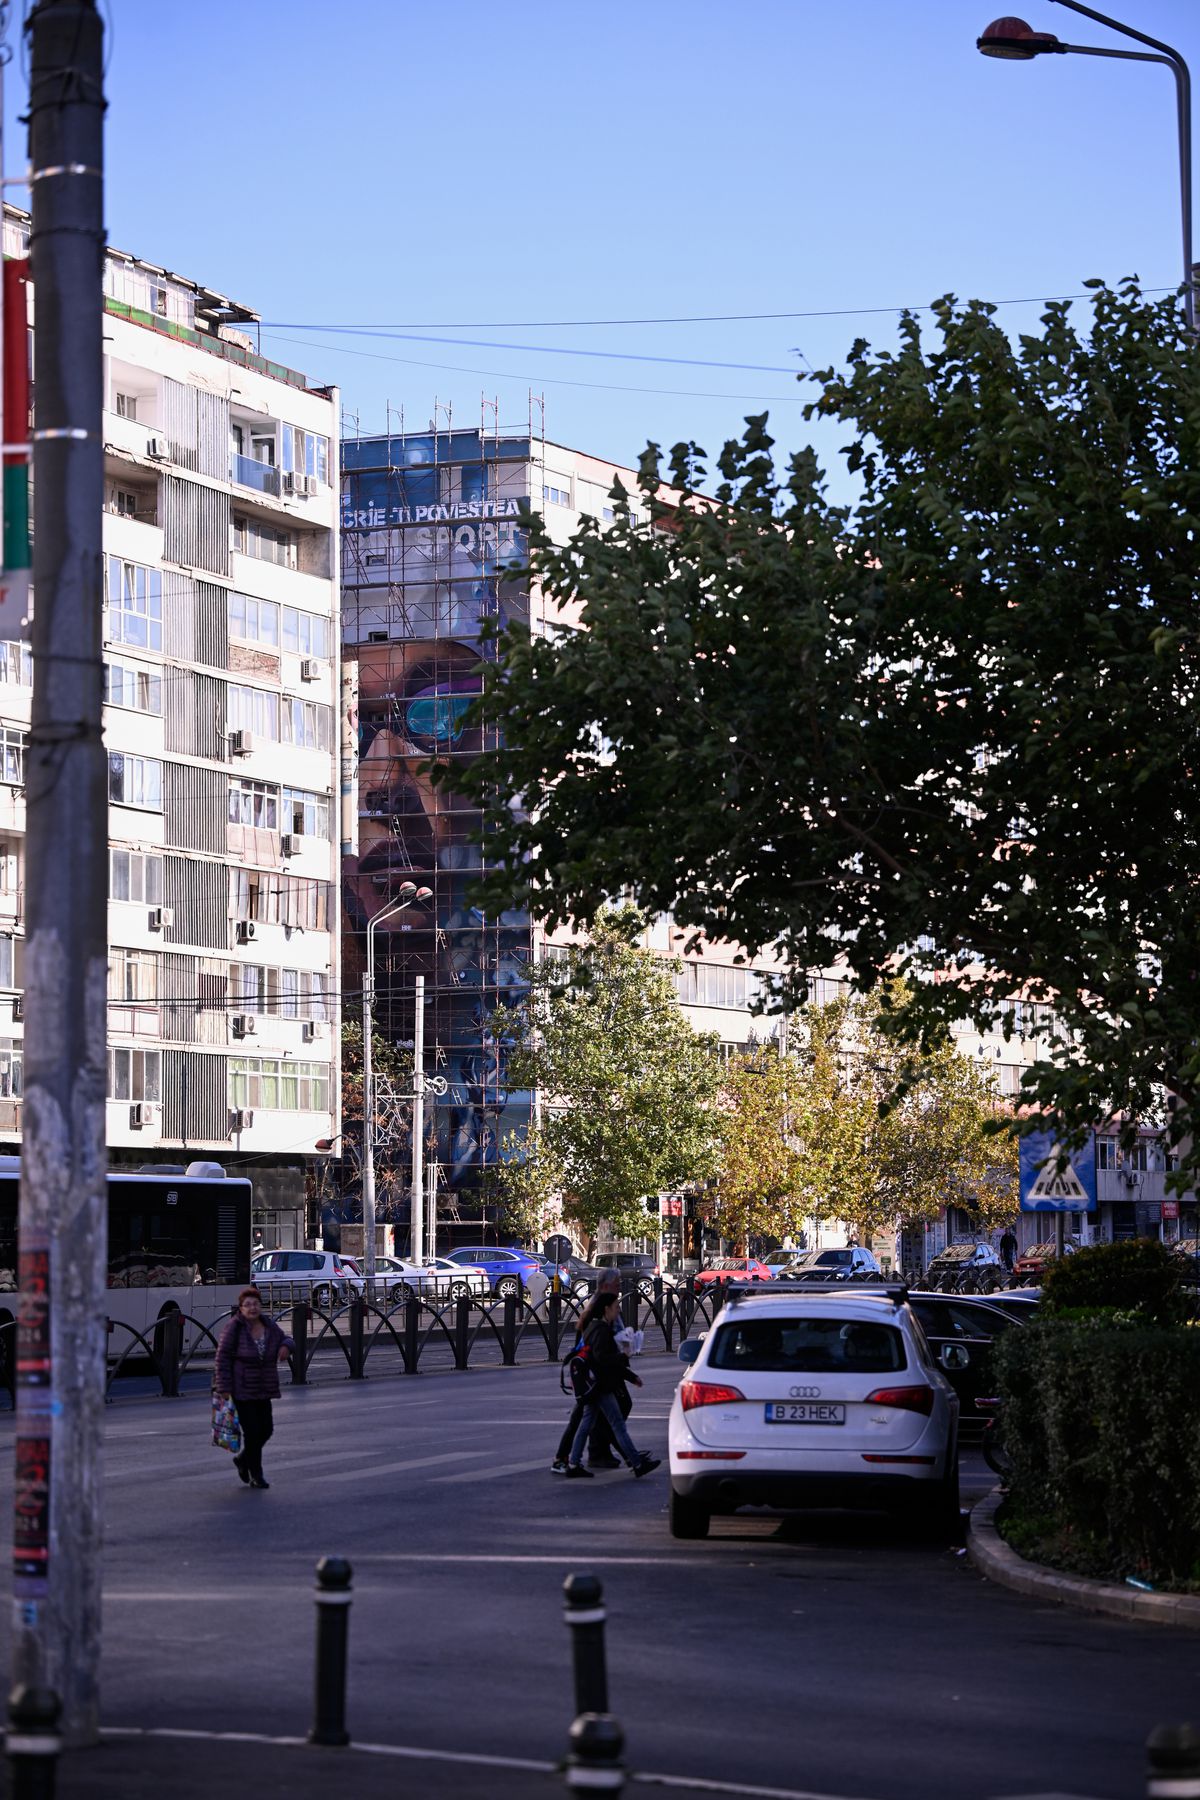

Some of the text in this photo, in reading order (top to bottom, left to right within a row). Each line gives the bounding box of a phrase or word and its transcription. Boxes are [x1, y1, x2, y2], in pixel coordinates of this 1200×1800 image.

[415, 498, 522, 523] POVESTEA
[416, 522, 521, 556] SPORT
[775, 1406, 838, 1420] B 23 HEK
